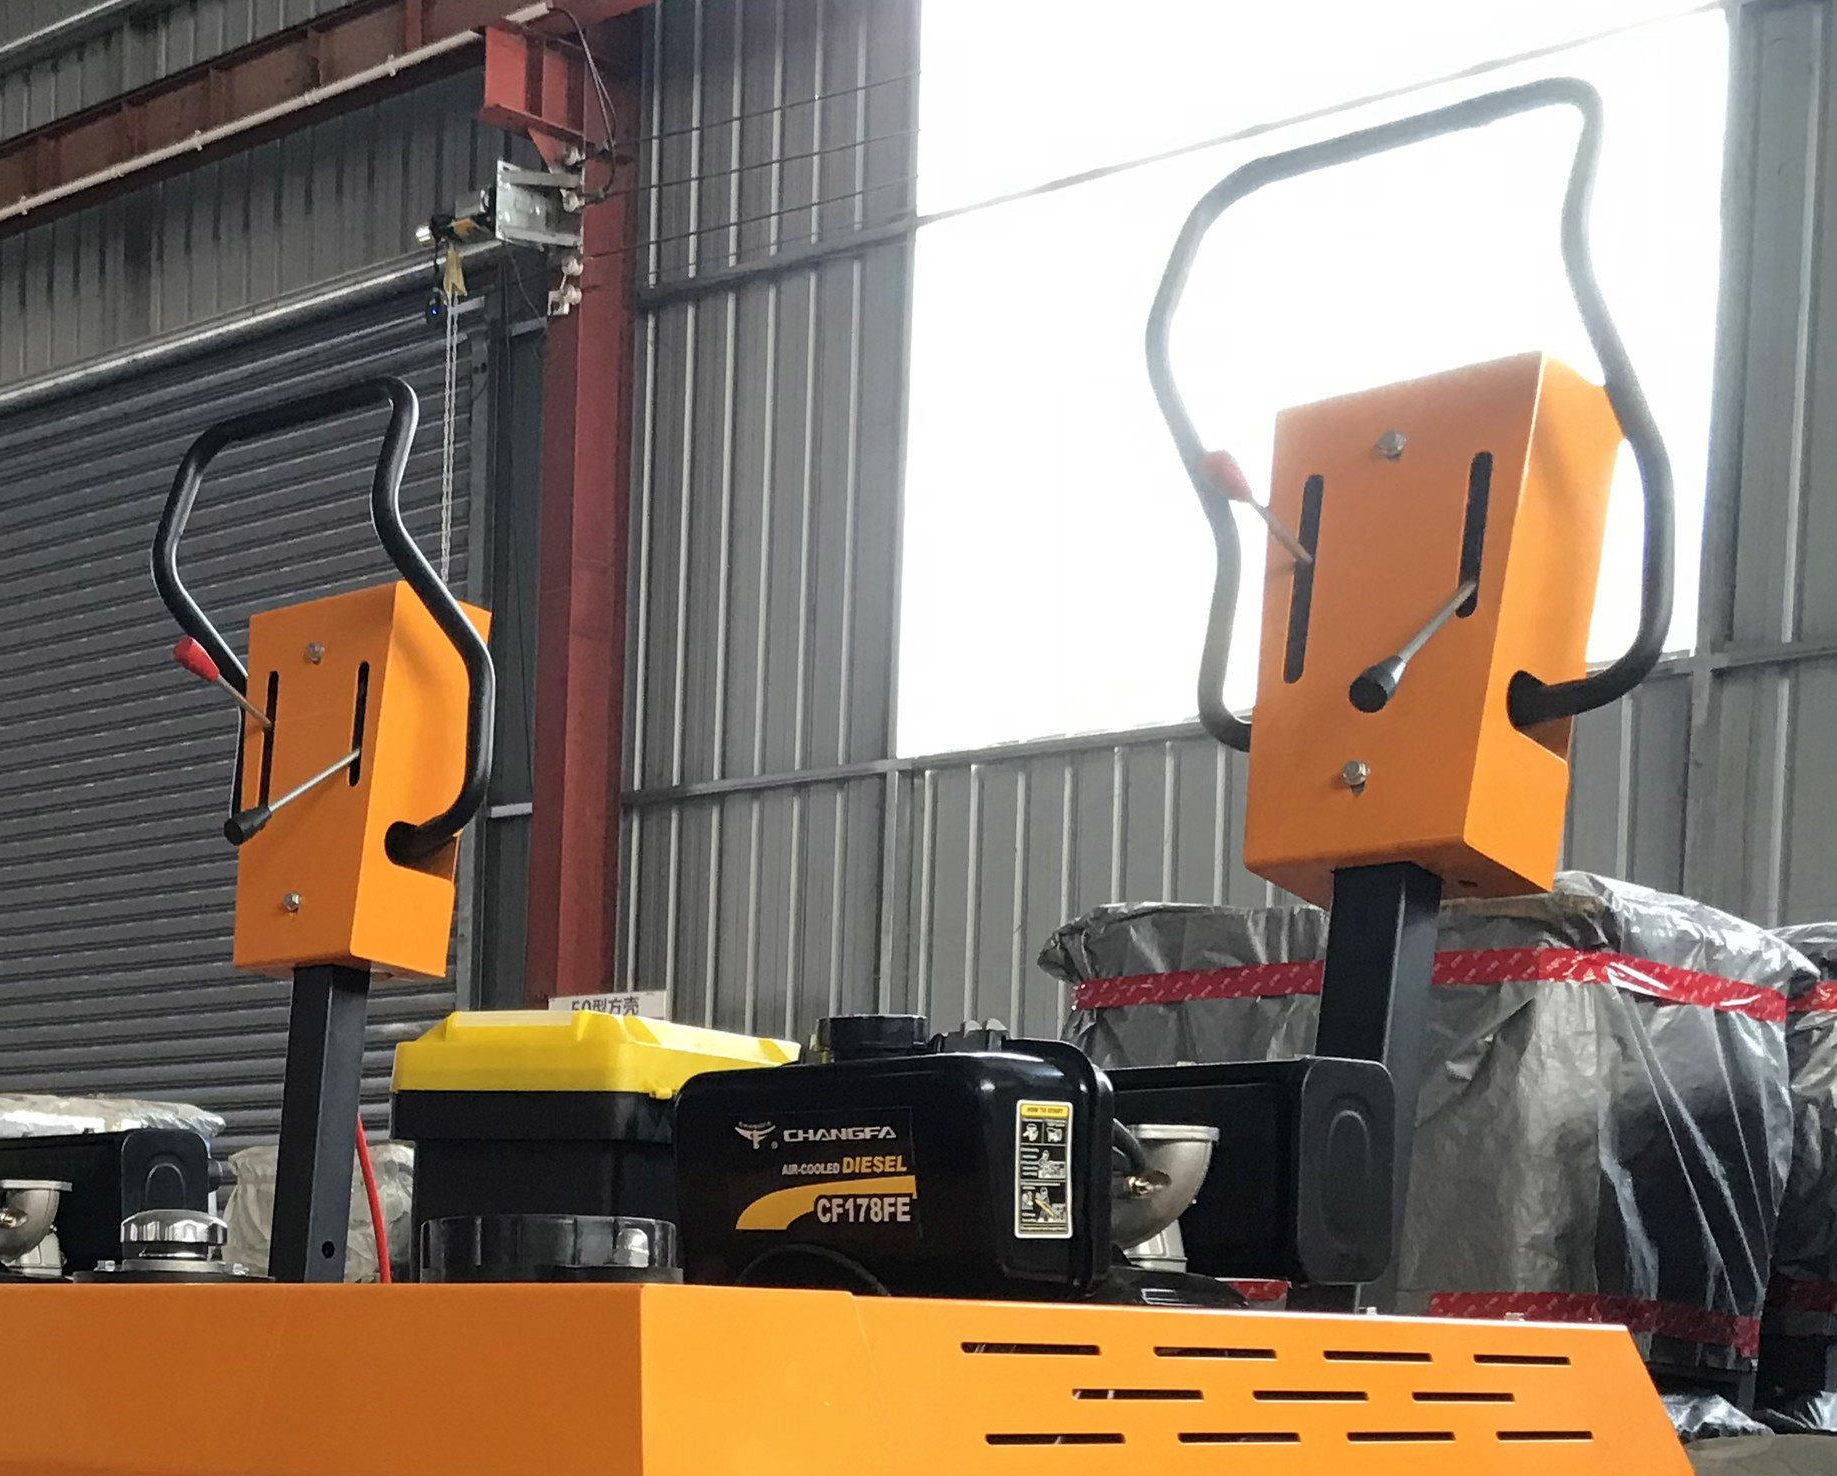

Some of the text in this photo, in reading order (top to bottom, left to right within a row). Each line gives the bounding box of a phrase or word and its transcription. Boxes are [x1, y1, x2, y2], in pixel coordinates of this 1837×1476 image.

[783, 1126, 897, 1142] CHANGFA
[781, 1154, 908, 1175] AIR-COOLED DIESEL
[816, 1196, 912, 1224] CF178FE
